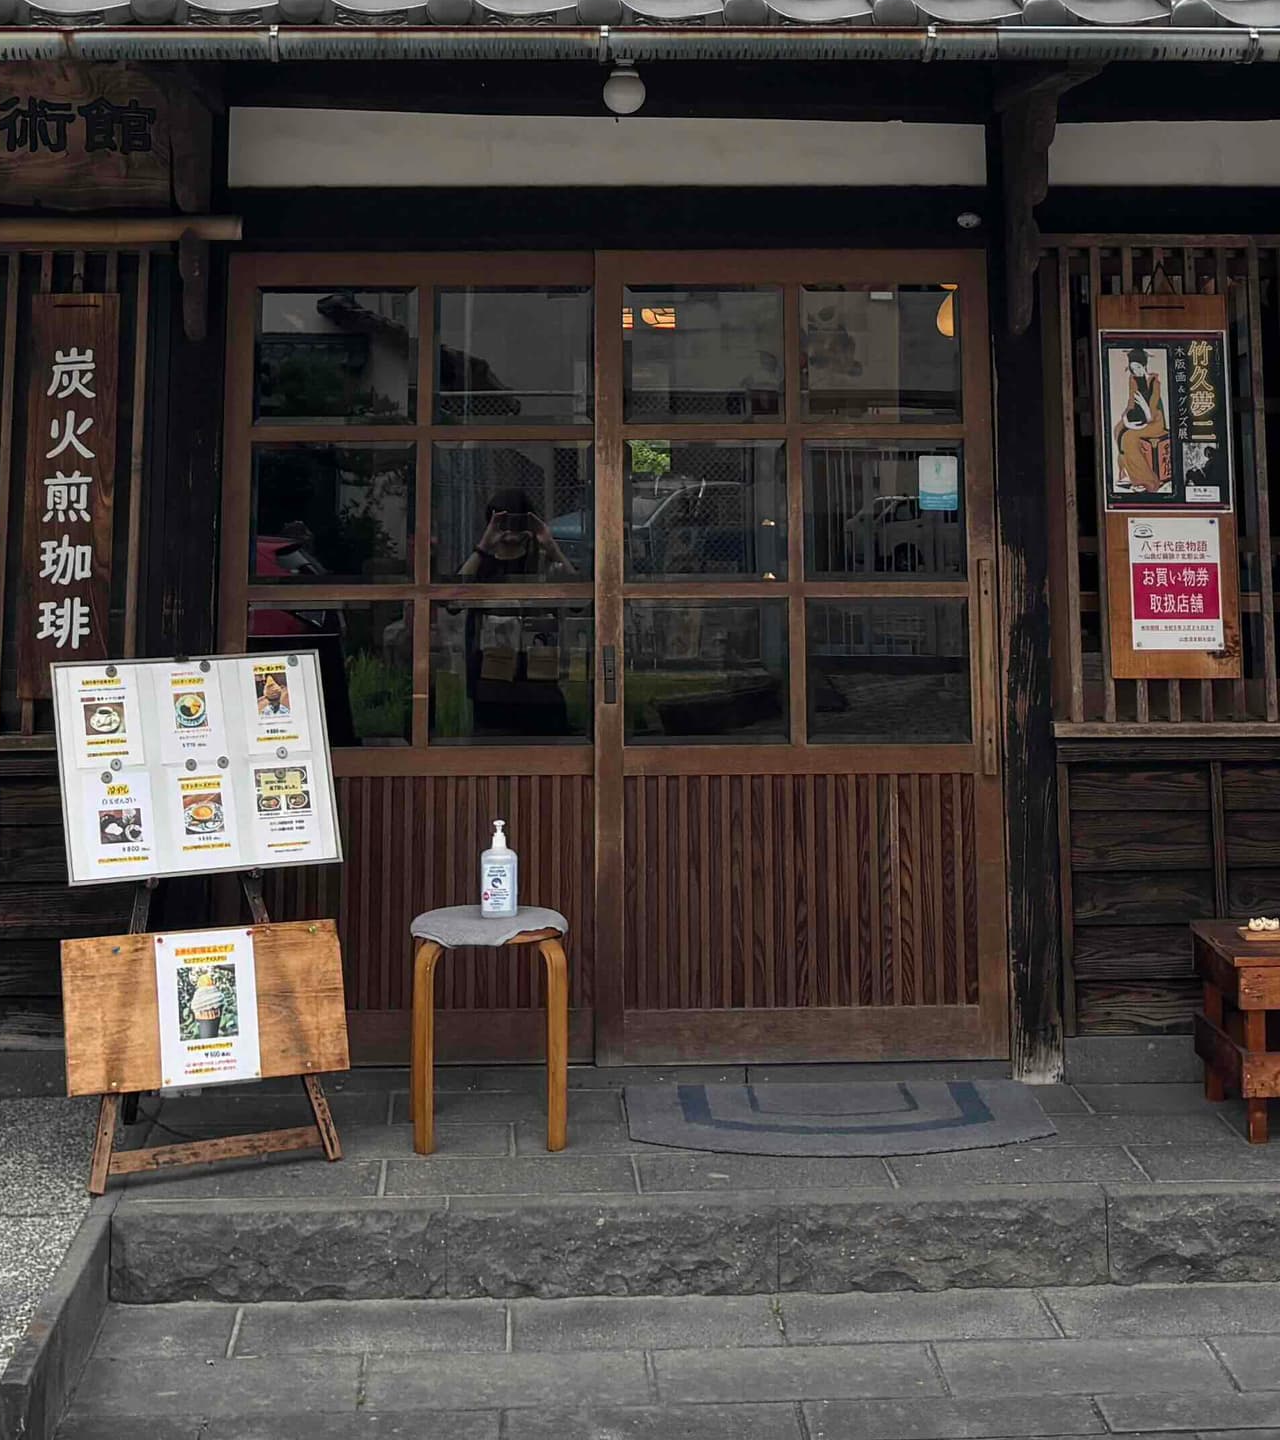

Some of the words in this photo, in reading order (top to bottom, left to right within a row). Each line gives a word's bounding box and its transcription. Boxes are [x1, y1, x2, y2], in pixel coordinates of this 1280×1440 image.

[1187, 340, 1217, 440] 竹久夢二
[36, 347, 97, 649] 炭火煎珈琲
[1142, 567, 1210, 587] お買い物券
[1150, 593, 1204, 613] 取扱店舗
